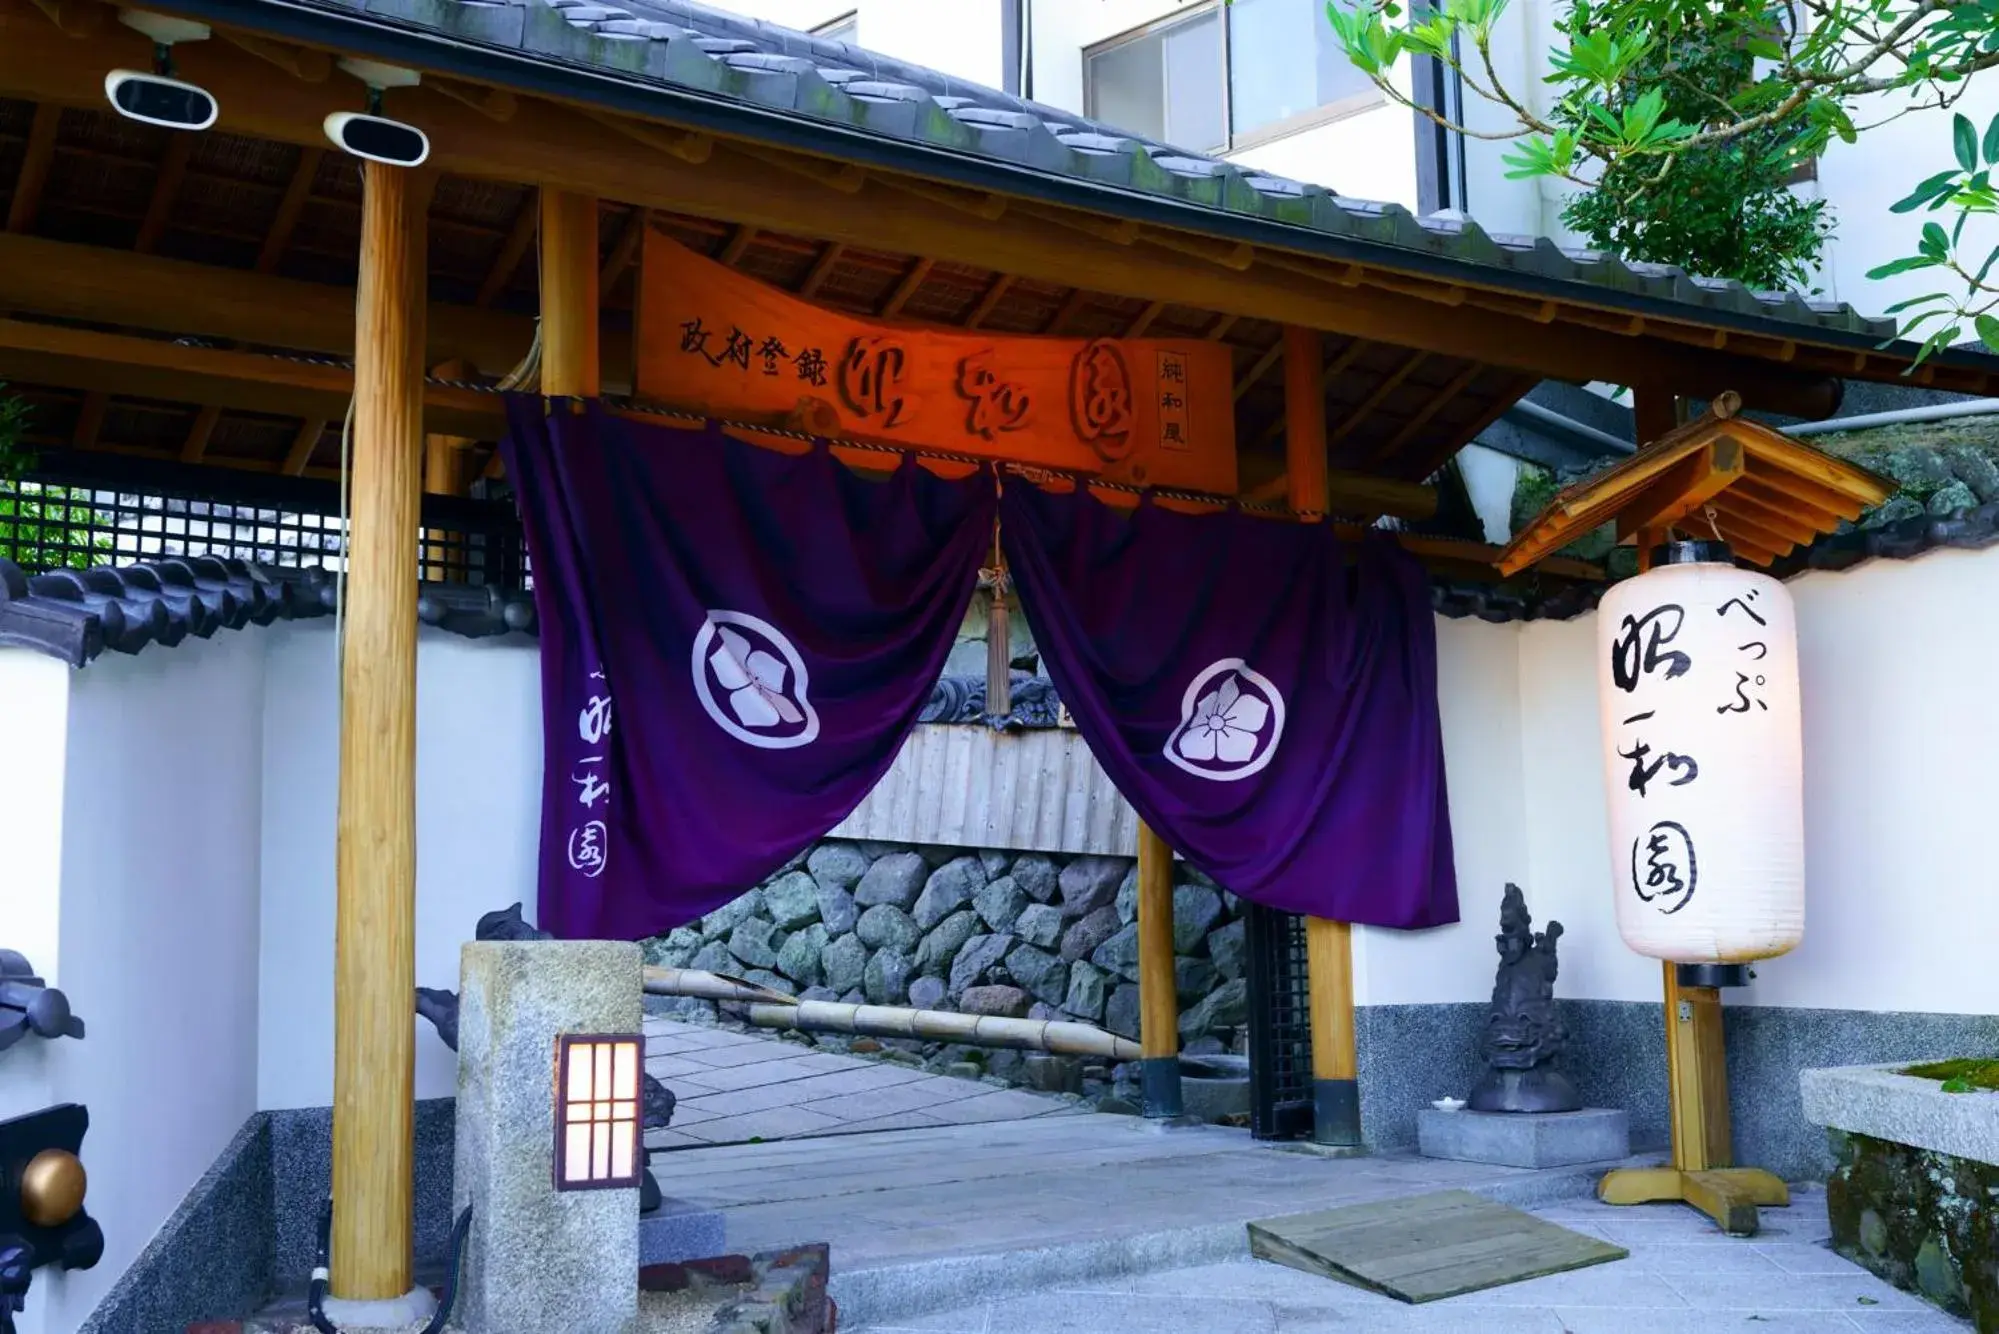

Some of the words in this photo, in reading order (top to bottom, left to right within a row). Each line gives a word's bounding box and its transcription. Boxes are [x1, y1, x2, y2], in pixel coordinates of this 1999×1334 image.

[680, 317, 828, 387] 政府登録
[1716, 589, 1768, 714] べっぷ
[1612, 604, 1698, 914] 昭和園
